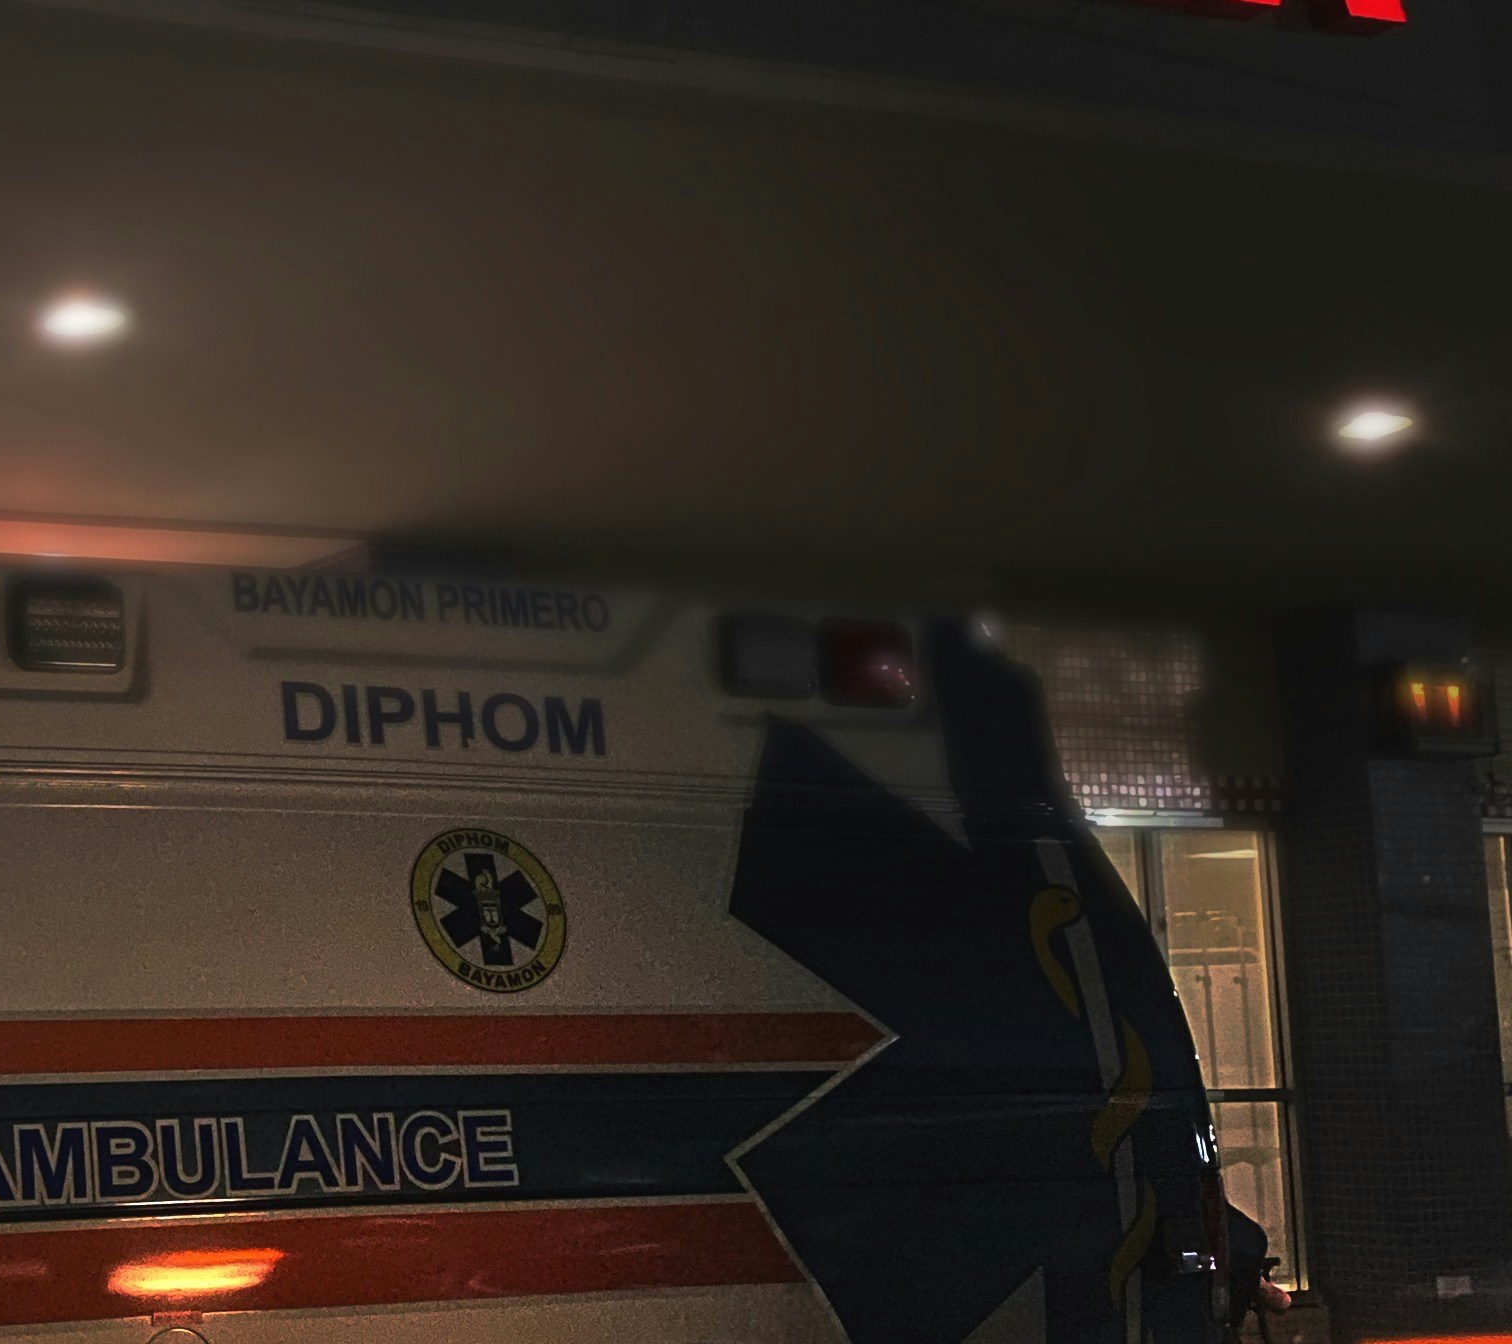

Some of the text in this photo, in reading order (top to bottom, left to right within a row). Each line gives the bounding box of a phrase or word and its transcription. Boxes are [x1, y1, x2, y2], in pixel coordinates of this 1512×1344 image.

[233, 572, 610, 632] BAYAMON PRIMERO
[281, 681, 607, 757] DIPHOM
[438, 833, 510, 854] DIPHOM
[458, 960, 546, 989] BAYAMON
